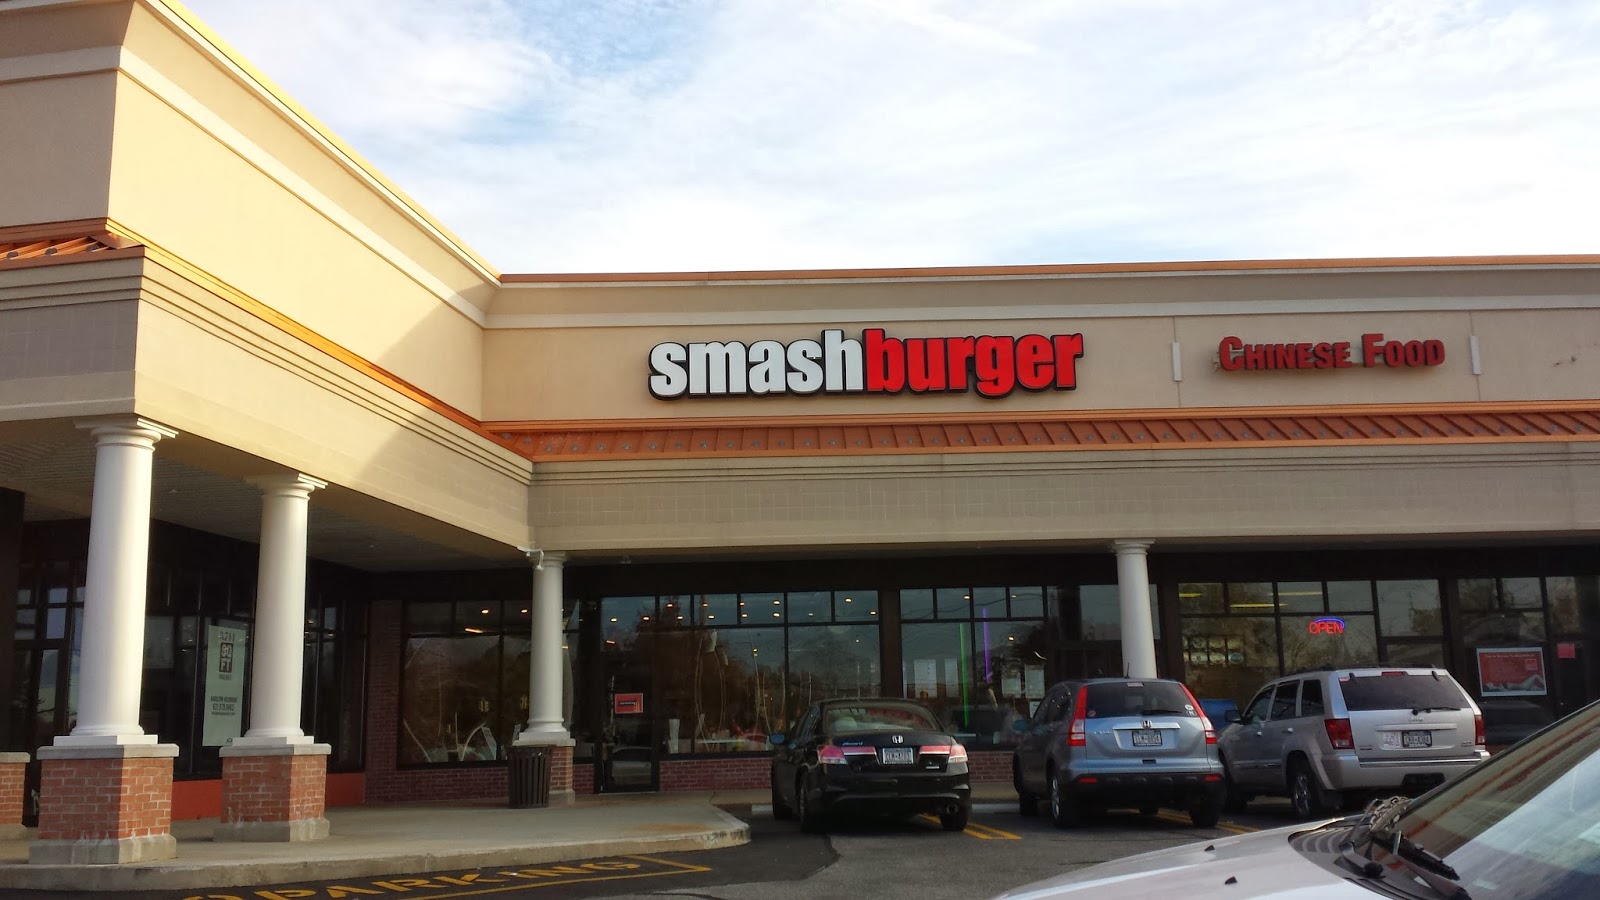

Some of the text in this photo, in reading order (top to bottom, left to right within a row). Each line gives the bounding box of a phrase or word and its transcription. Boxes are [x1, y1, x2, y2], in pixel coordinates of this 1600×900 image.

[648, 328, 1084, 399] smashburger
[1218, 333, 1446, 372] CHINESE FOOD
[1307, 621, 1344, 635] OPEN
[221, 644, 232, 657] SQ
[220, 659, 231, 671] FT
[254, 861, 641, 900] PARKING
